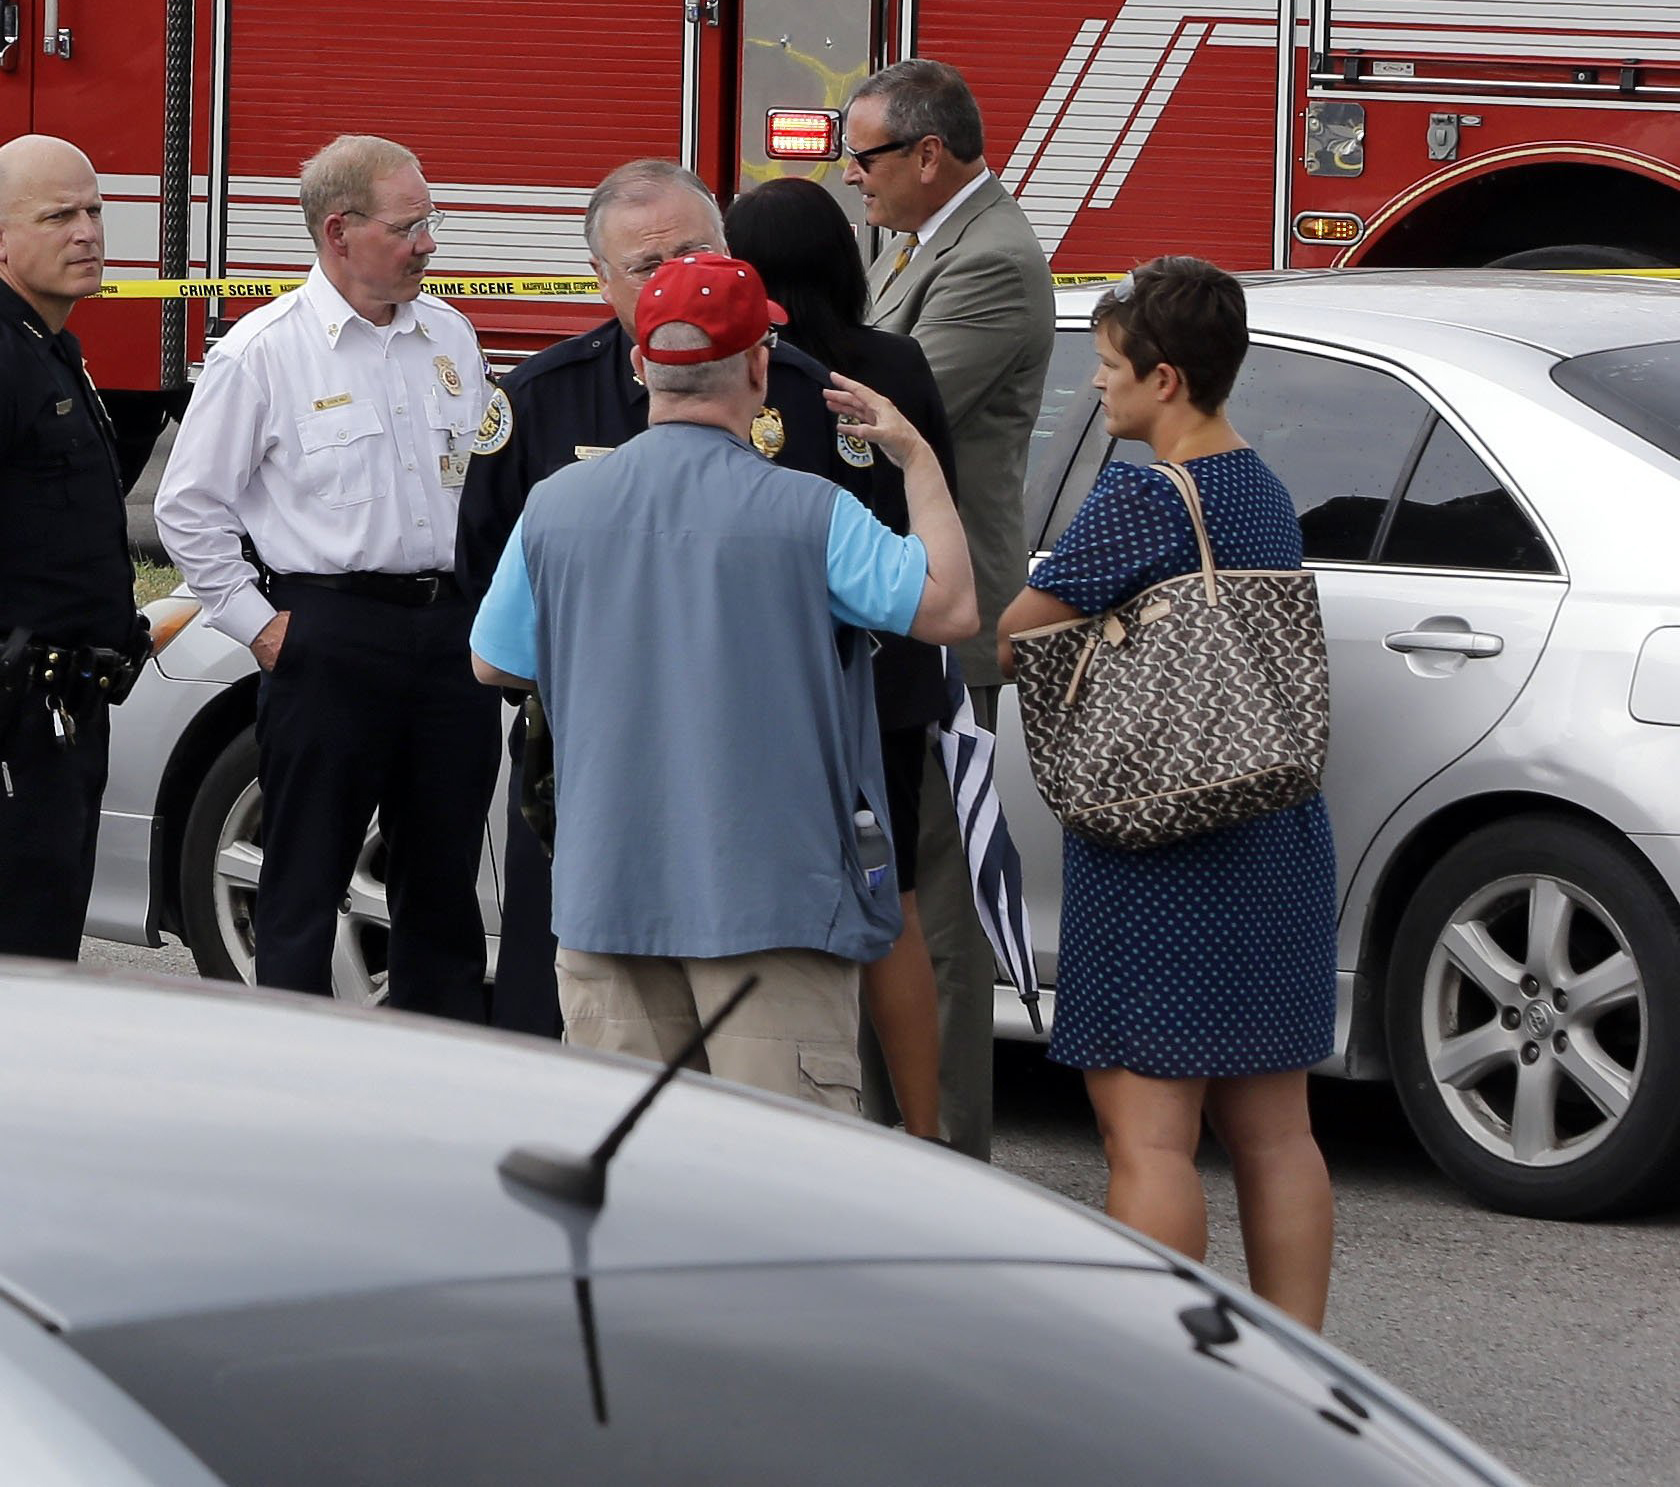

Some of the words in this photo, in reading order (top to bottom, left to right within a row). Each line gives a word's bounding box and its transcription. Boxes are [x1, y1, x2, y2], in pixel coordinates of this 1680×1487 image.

[179, 284, 224, 297] CRIME
[229, 284, 273, 297] SCENE
[420, 282, 465, 294] CRIME
[470, 282, 515, 295] SCENE
